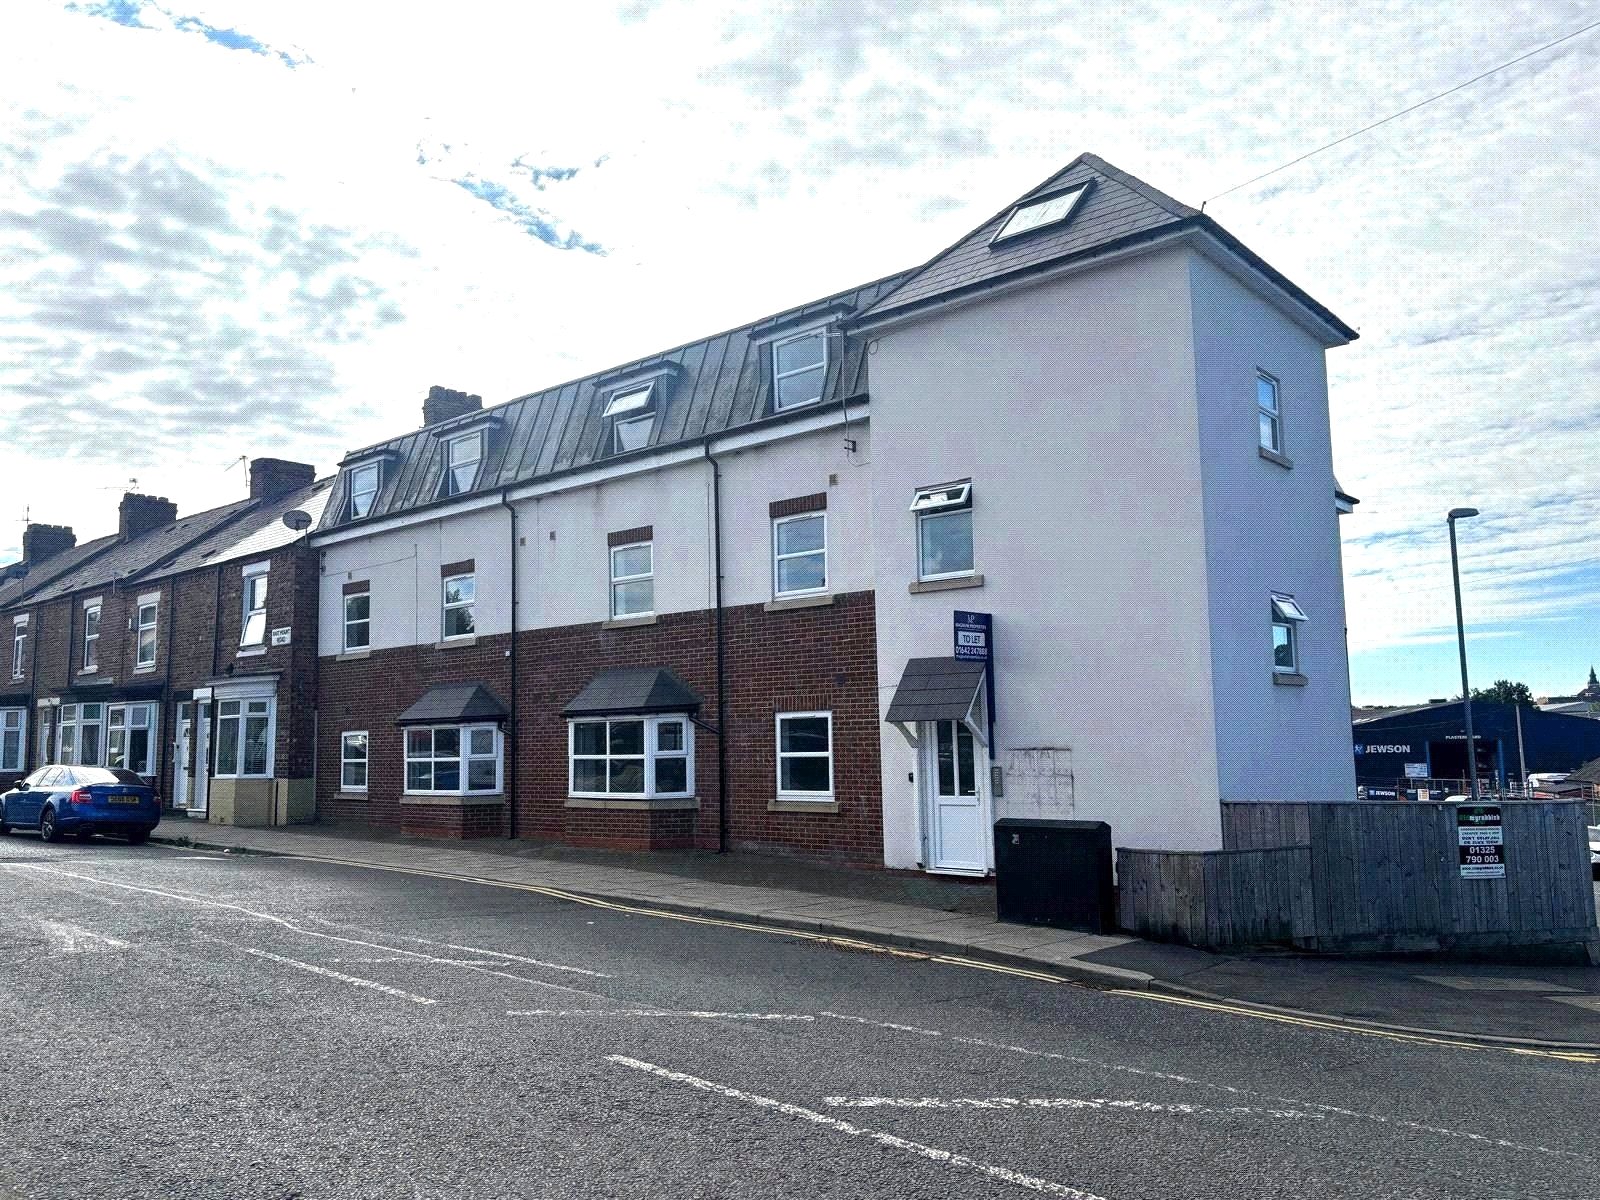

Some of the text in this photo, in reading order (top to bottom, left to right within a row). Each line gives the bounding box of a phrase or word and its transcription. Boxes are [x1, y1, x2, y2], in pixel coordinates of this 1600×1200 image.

[963, 634, 981, 644] TO LET
[1365, 744, 1411, 753] JEWSON
[1469, 846, 1495, 854] 01325
[1465, 855, 1499, 863] 790 003
